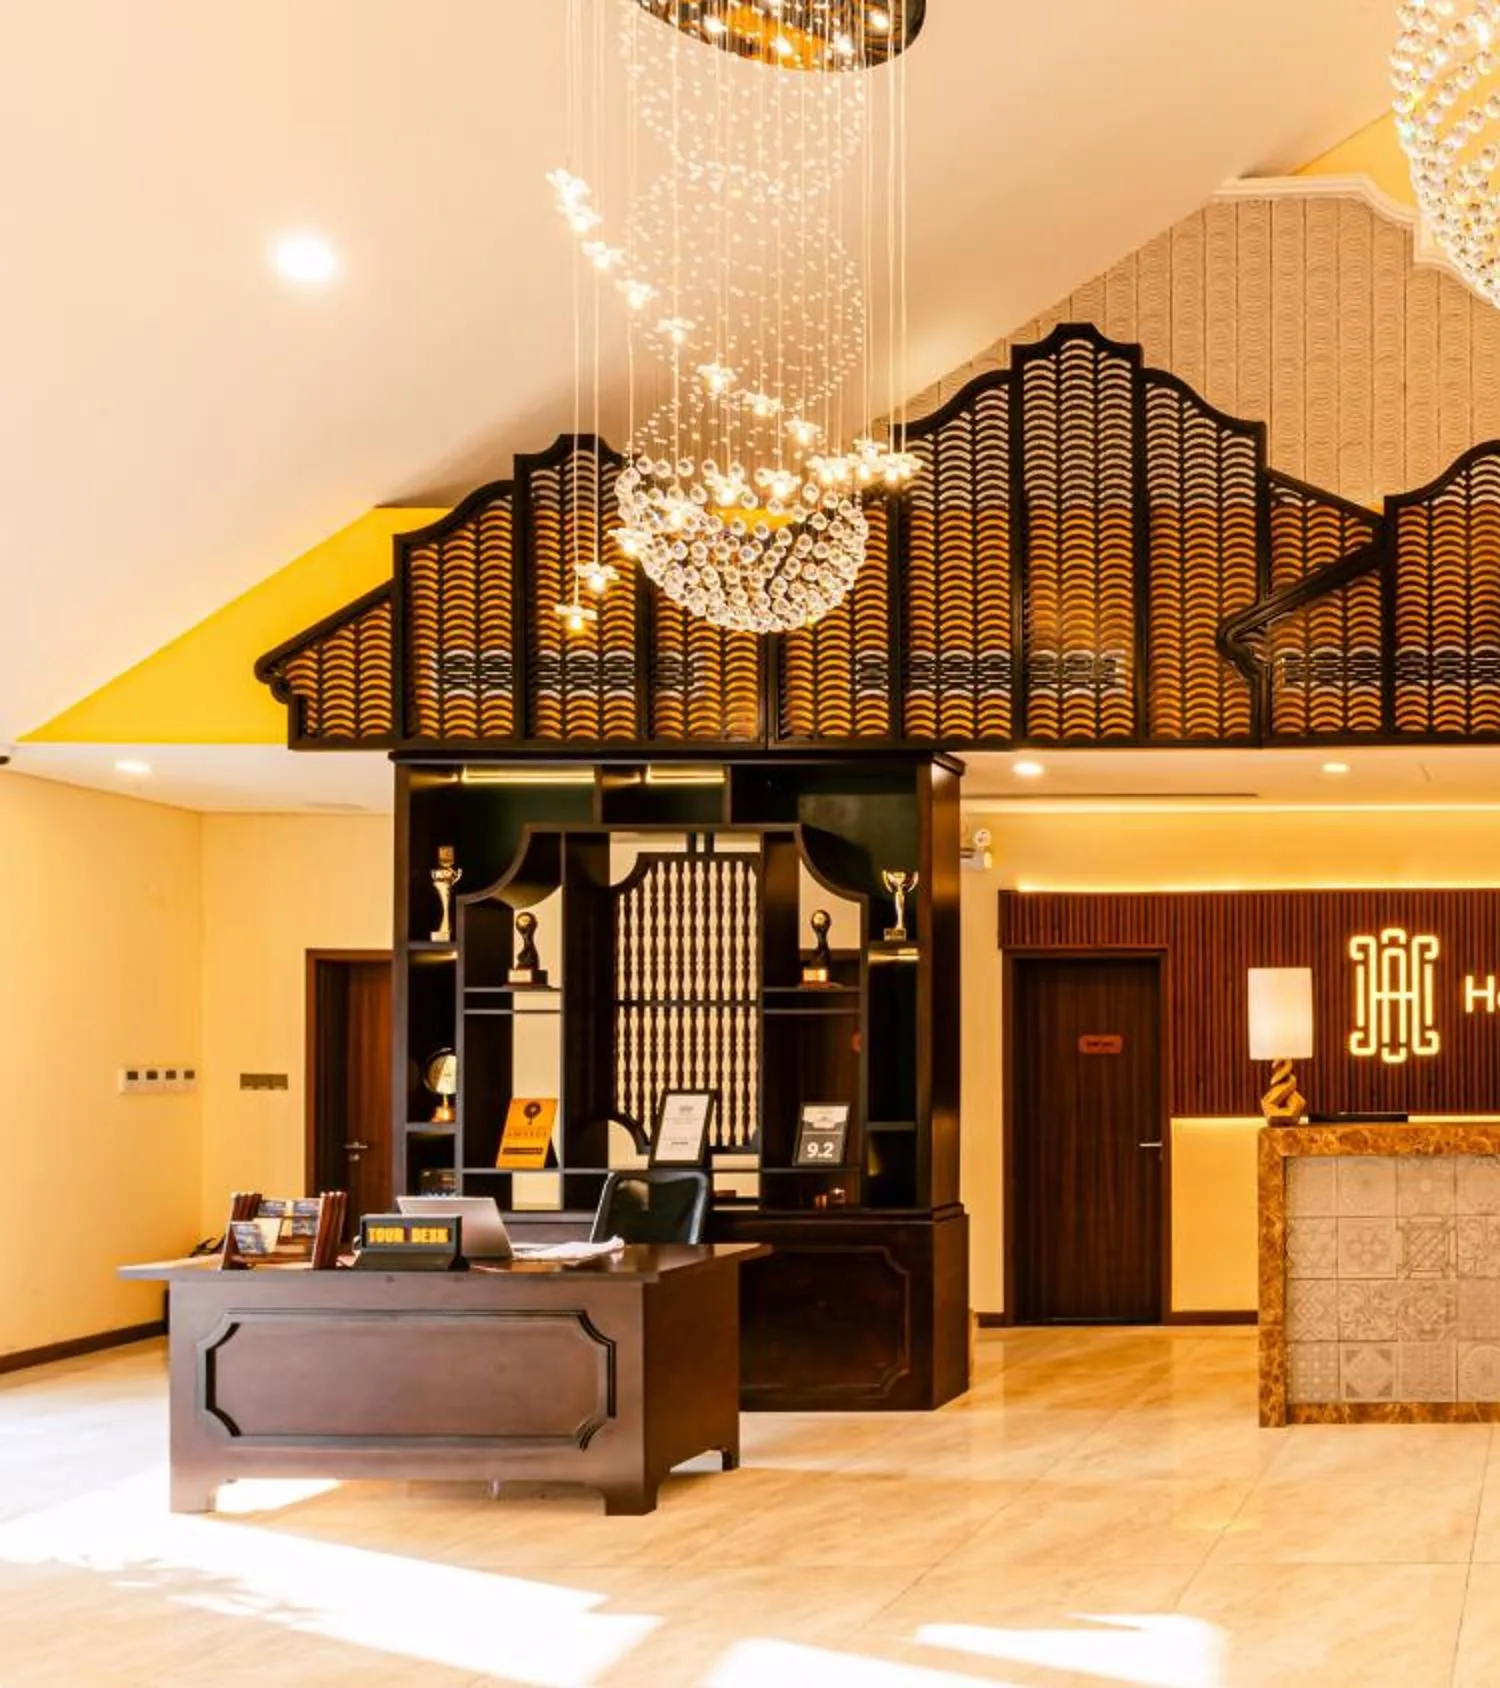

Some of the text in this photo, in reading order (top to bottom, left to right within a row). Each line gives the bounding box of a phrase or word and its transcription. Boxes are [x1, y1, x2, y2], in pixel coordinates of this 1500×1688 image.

[807, 1141, 834, 1159] 9.2
[367, 1226, 449, 1244] TOUR DESK
